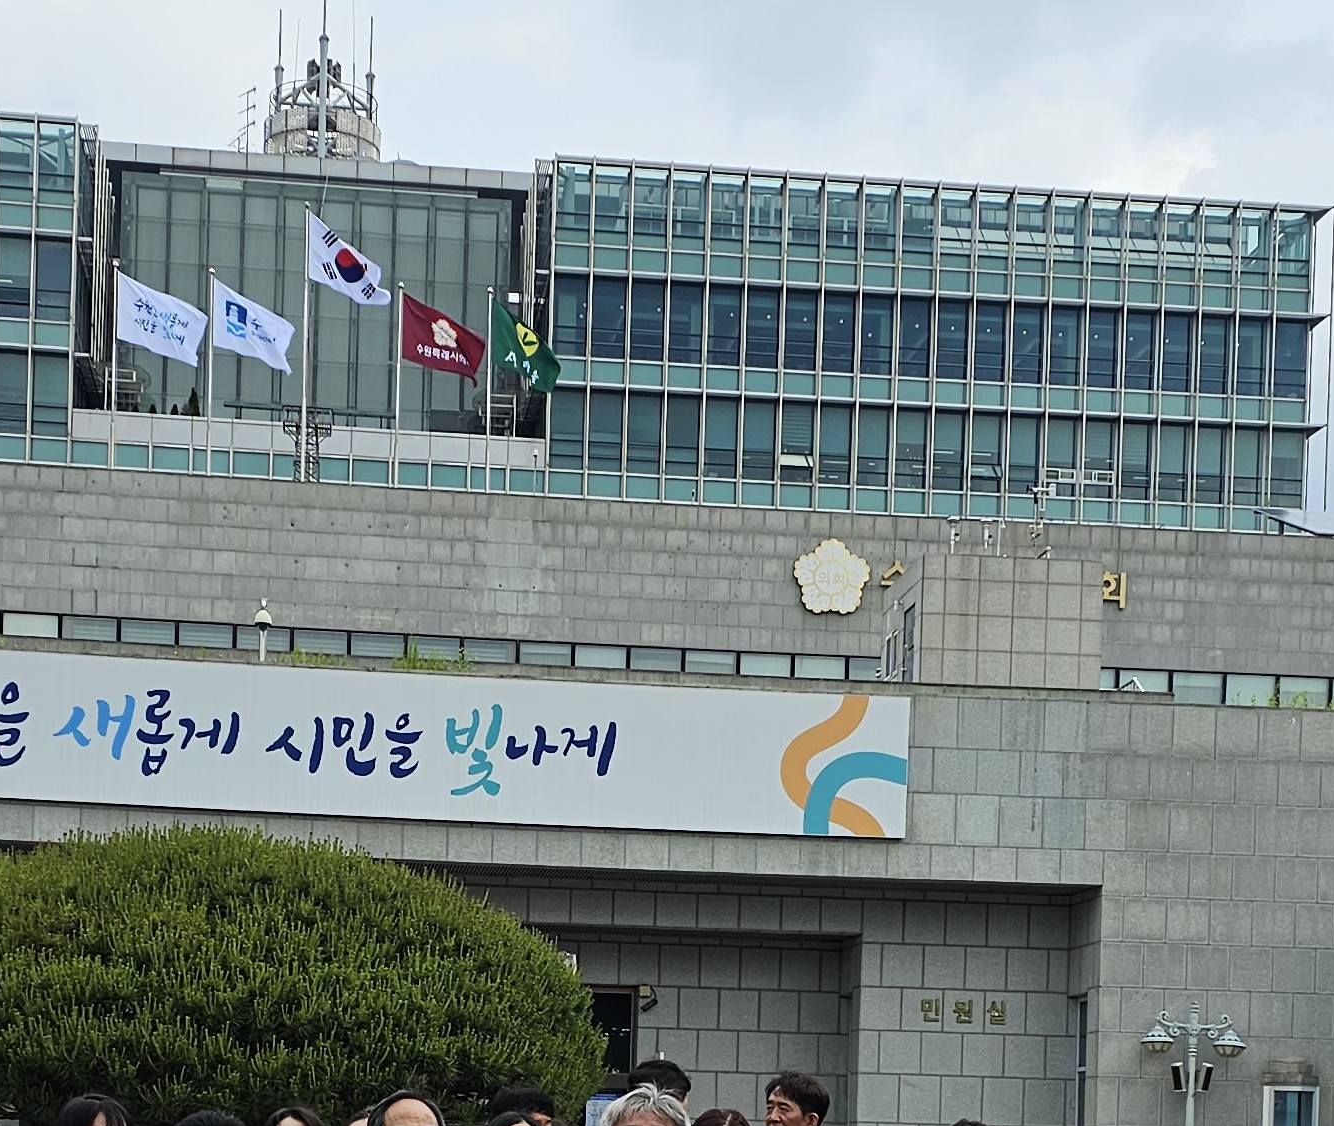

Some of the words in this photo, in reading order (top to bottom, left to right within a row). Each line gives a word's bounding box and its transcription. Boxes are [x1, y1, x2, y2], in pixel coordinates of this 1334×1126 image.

[55, 690, 239, 776] 새롭게
[265, 700, 422, 778] 시민을
[446, 705, 616, 795] 빛나게
[920, 998, 1007, 1025] 민원실
